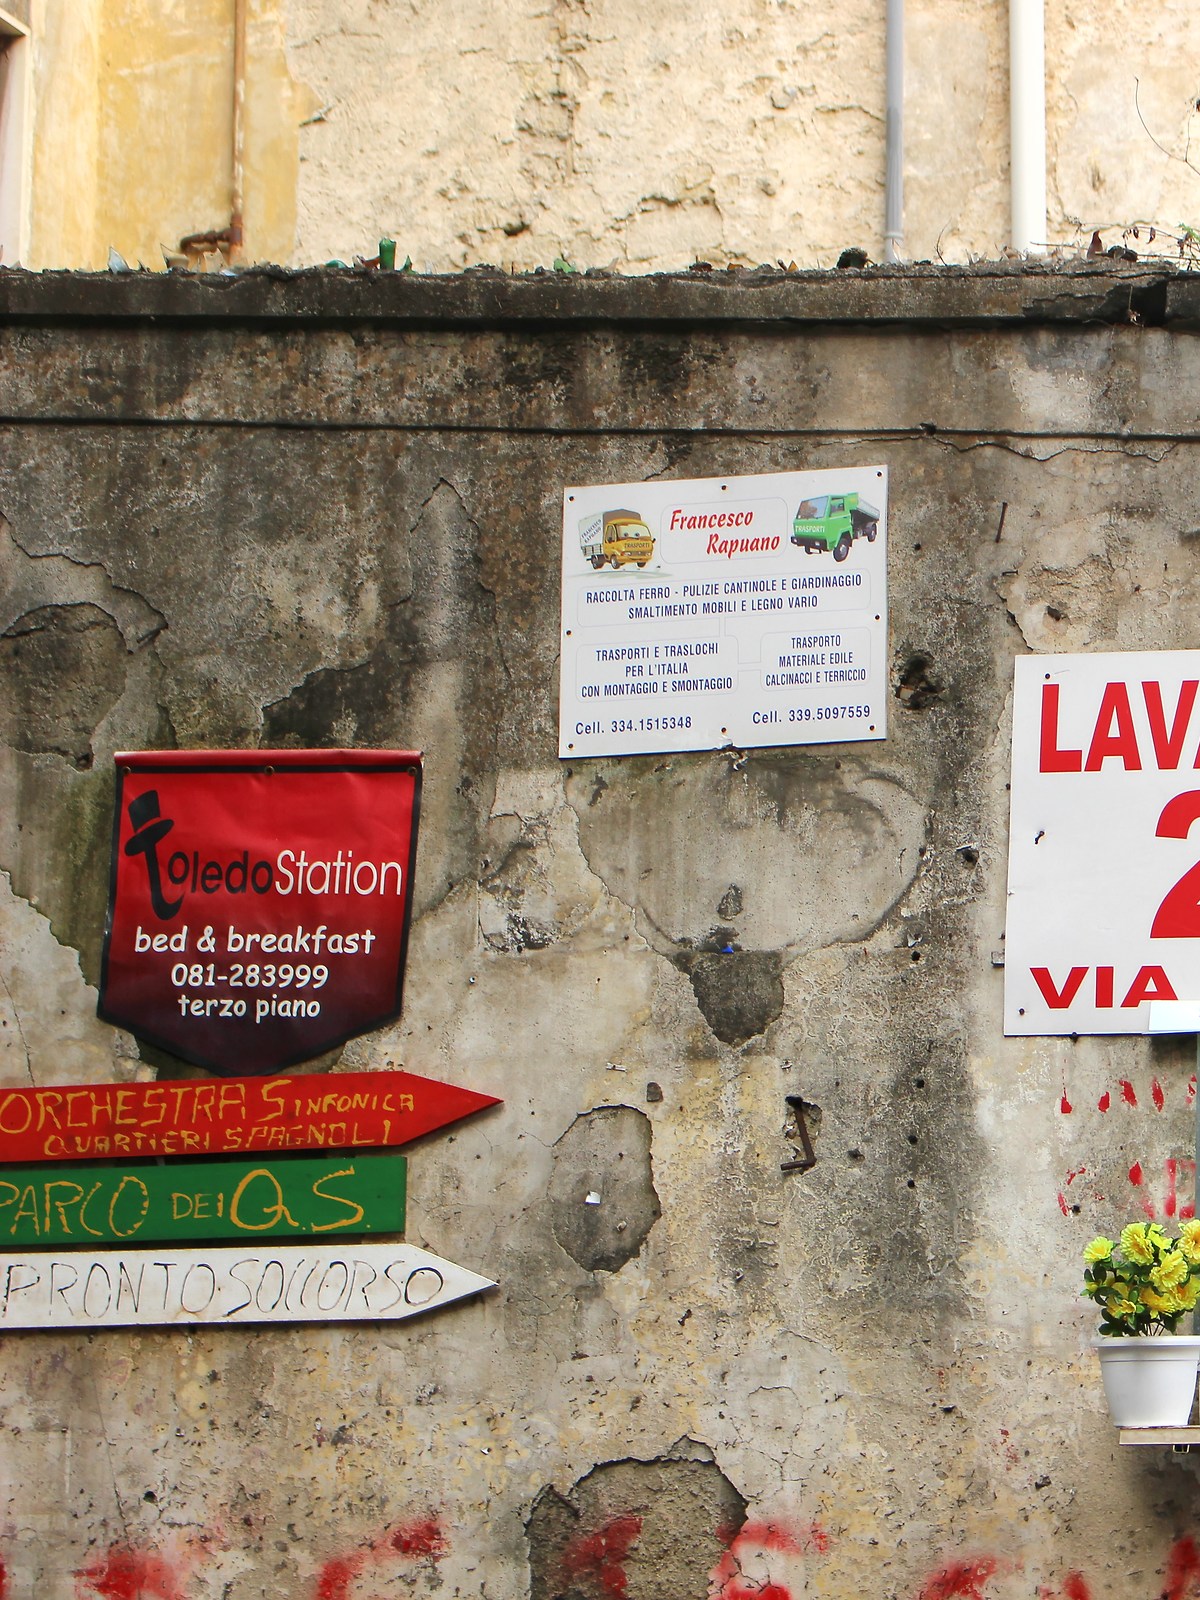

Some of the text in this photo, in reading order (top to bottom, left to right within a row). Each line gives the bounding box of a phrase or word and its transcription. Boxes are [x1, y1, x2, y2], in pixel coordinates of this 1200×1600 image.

[670, 510, 753, 530] Francesco
[795, 525, 825, 533] TRASPORTI
[707, 533, 780, 559] Rapuano
[586, 590, 635, 603] RACCOLTA
[639, 587, 671, 599] FERRO
[683, 584, 720, 597] PULIZIE
[723, 580, 777, 594] CANTINOLE
[781, 579, 787, 590] E
[791, 574, 862, 589] GIARDINAGGIO
[628, 596, 818, 619] SMALTIMENTO MOBILI E LEGNO VARIO
[595, 643, 718, 661] TRASPORTI E TRASLOCHI
[791, 635, 841, 649] TRASPORTO
[778, 652, 853, 667] MATERIALE EDILE
[625, 663, 689, 677] PER L'ITALIA
[765, 669, 866, 686] CALCINACCI E TERRICCIO
[581, 677, 733, 697] CON MONTAGGIO E SMONTAGGIO
[752, 705, 871, 724] Cell. 339.5097559
[575, 716, 692, 735] Cell. 334.1515348
[135, 926, 375, 954] bed & breakfast
[172, 964, 328, 988] 081-283999
[1030, 966, 1178, 1008] VIA
[178, 994, 320, 1023] terzo piano
[0, 1084, 246, 1134] ORCHESTRA
